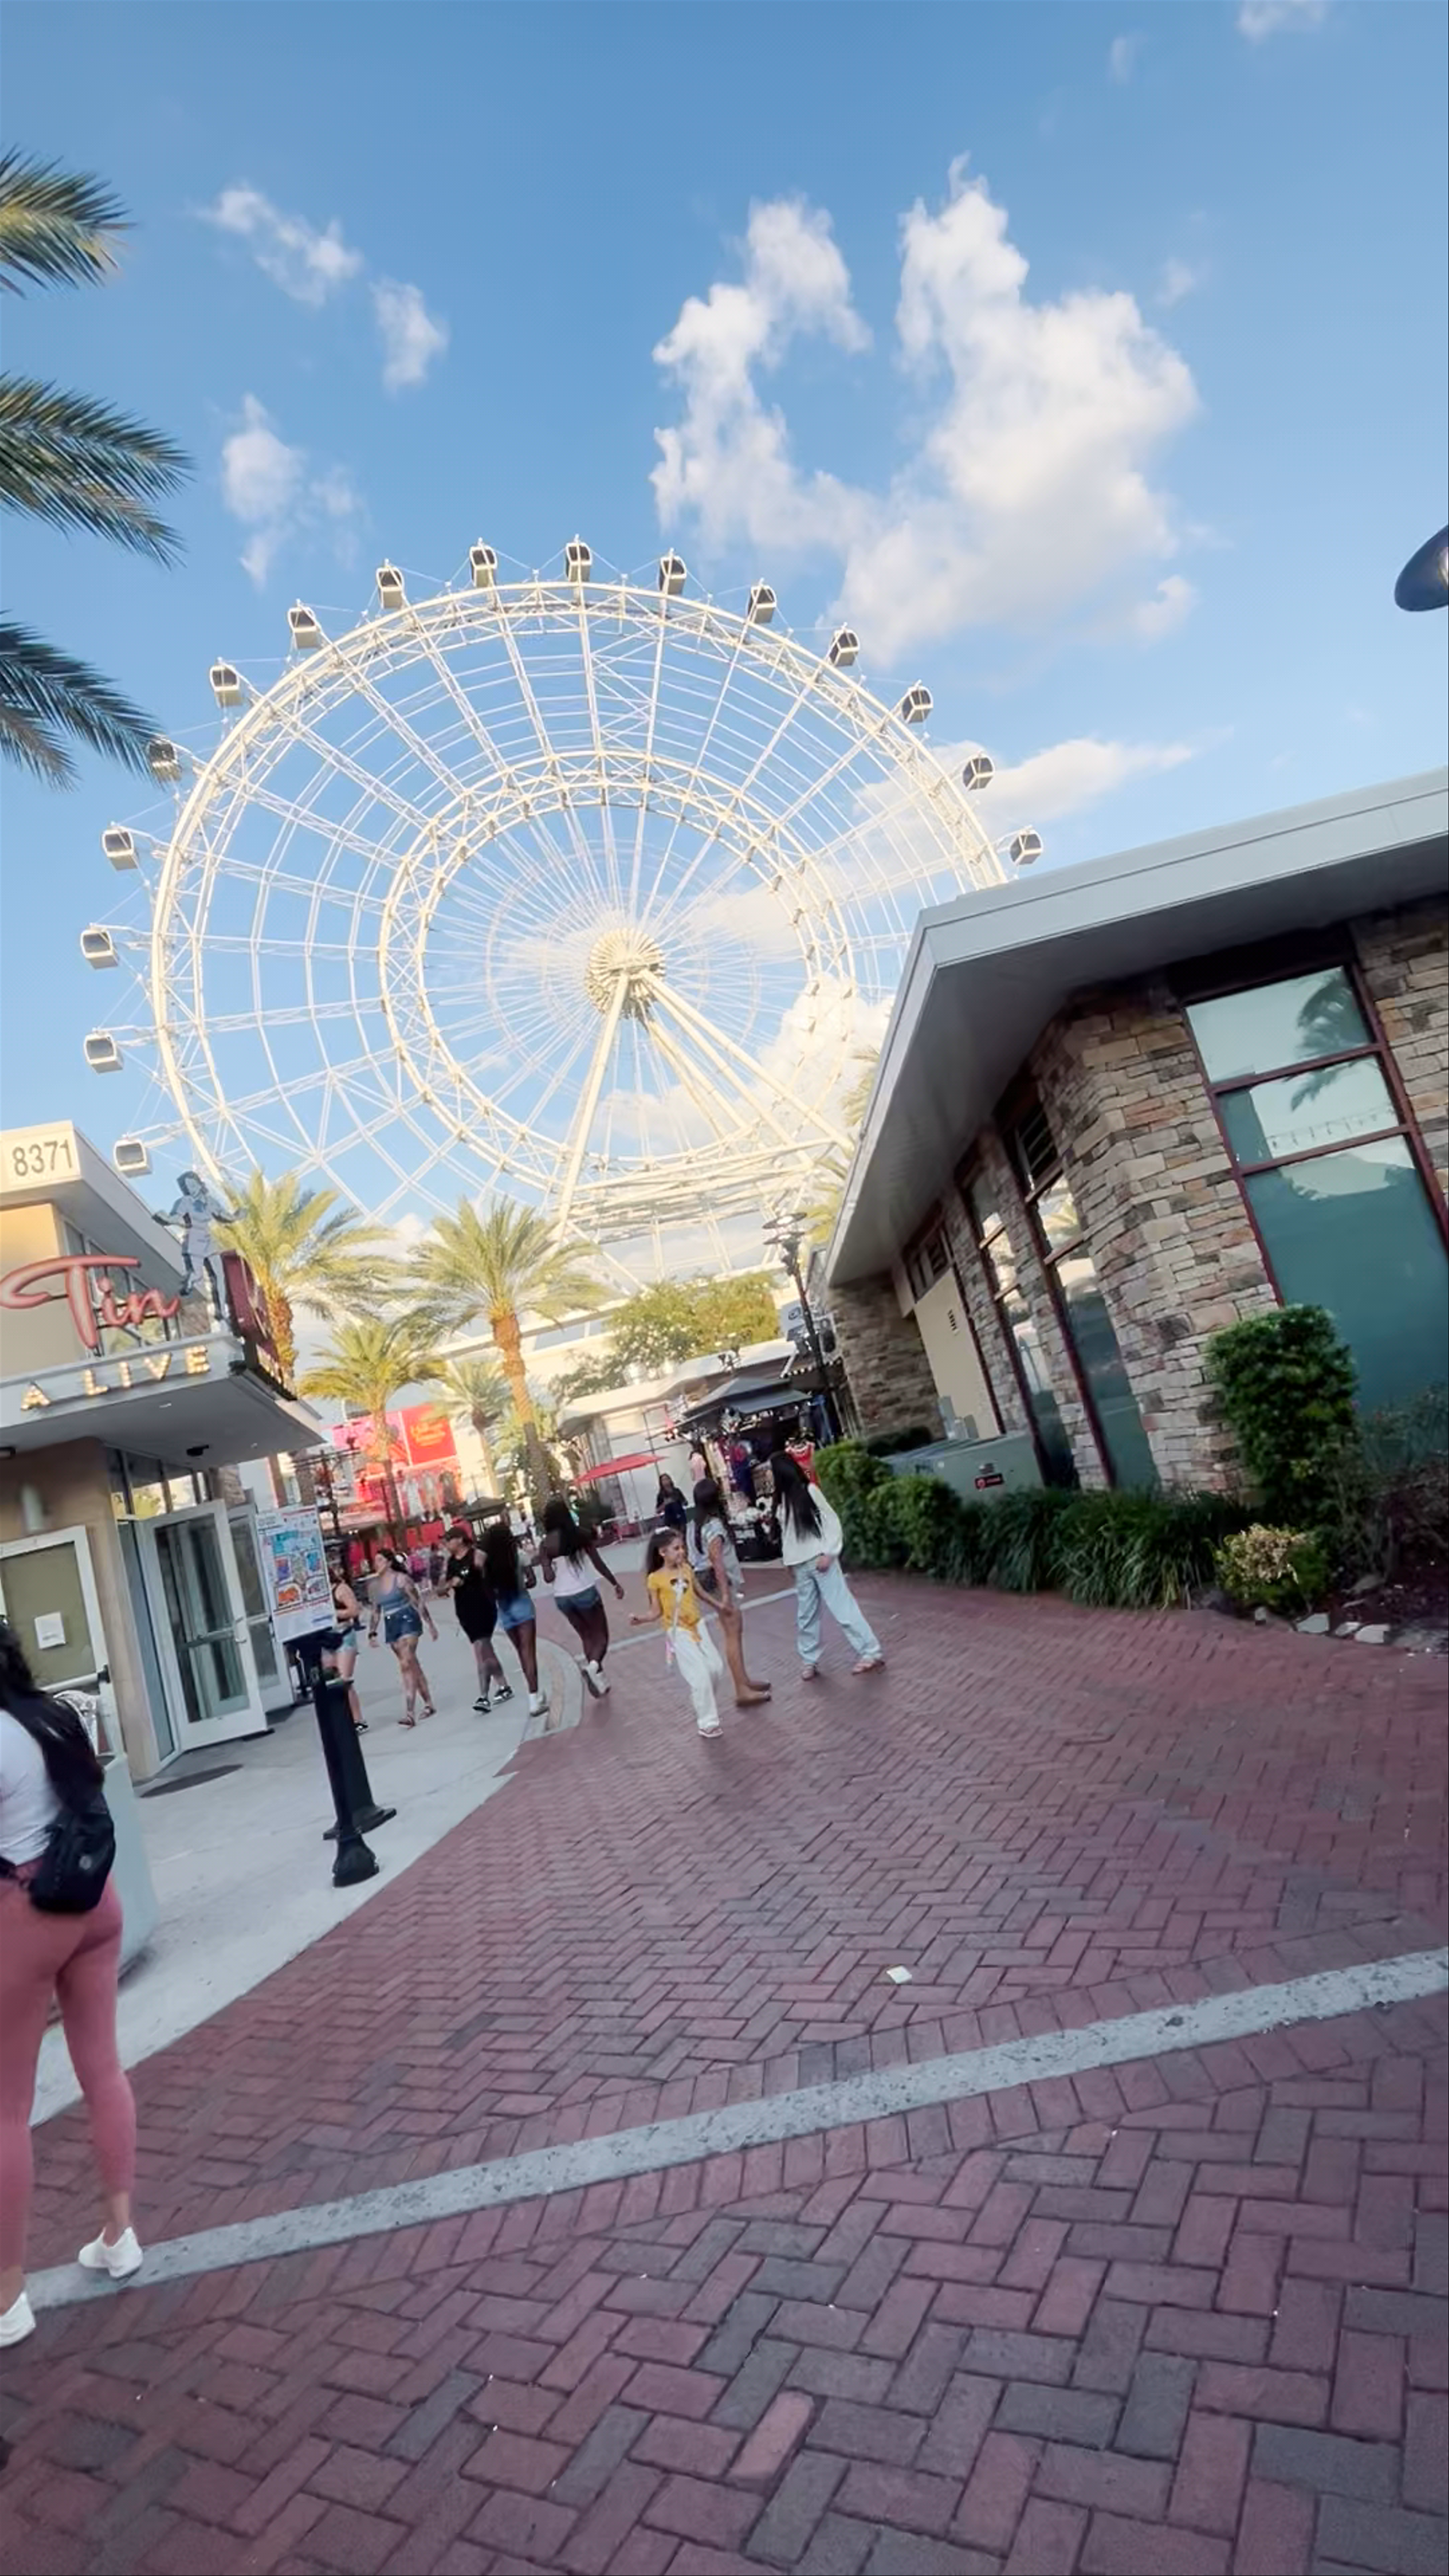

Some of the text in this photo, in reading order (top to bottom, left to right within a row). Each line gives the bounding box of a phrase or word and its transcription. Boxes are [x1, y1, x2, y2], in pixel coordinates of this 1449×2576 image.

[12, 1139, 73, 1177] 8371
[0, 1255, 181, 1349] Tin
[83, 1345, 211, 1396] LIVE
